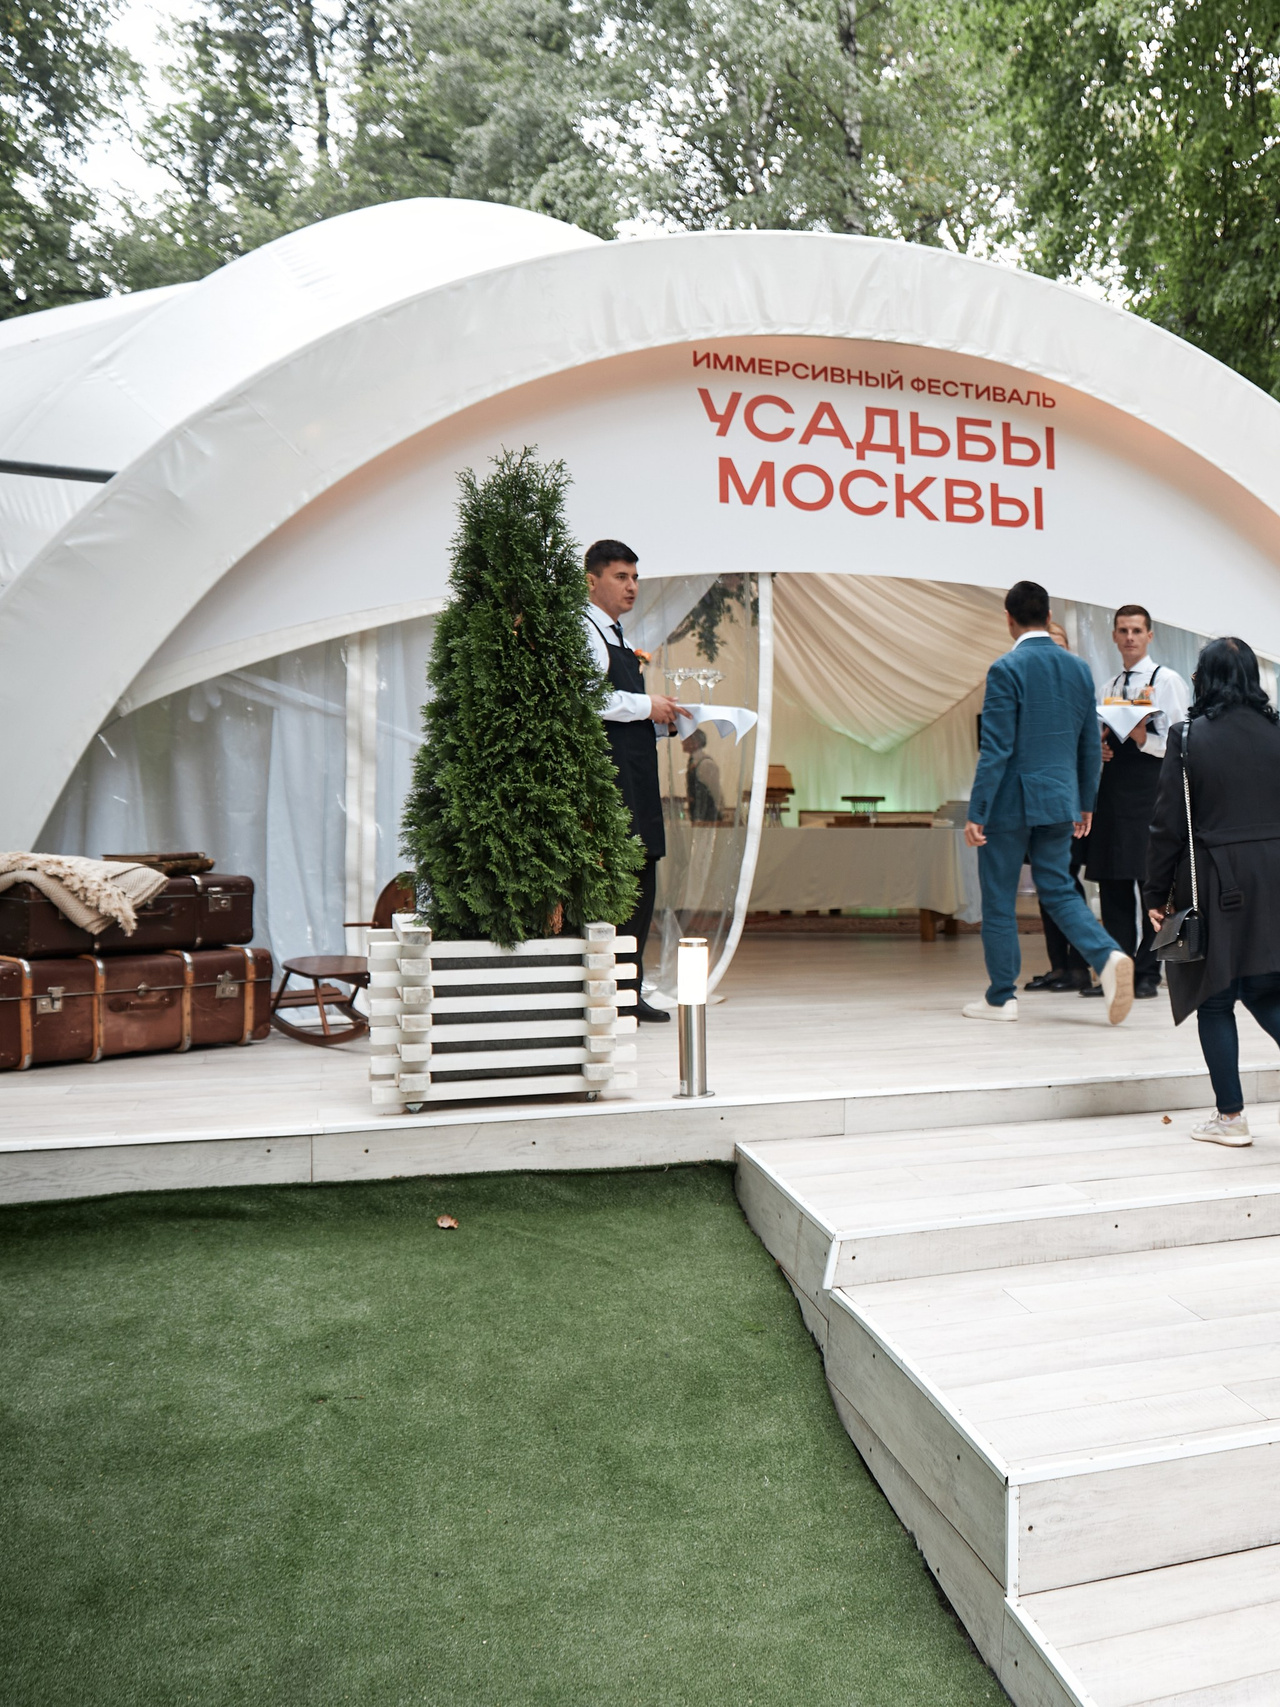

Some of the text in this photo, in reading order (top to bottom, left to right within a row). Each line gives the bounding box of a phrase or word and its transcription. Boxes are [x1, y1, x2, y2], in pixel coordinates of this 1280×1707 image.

[692, 350, 1057, 409] ИММЕРСИВНЫЙ ФЕСТИВАЛЬ
[697, 387, 1056, 470] УСАДЬБЫ
[718, 456, 1044, 530] МОСКВЫ
